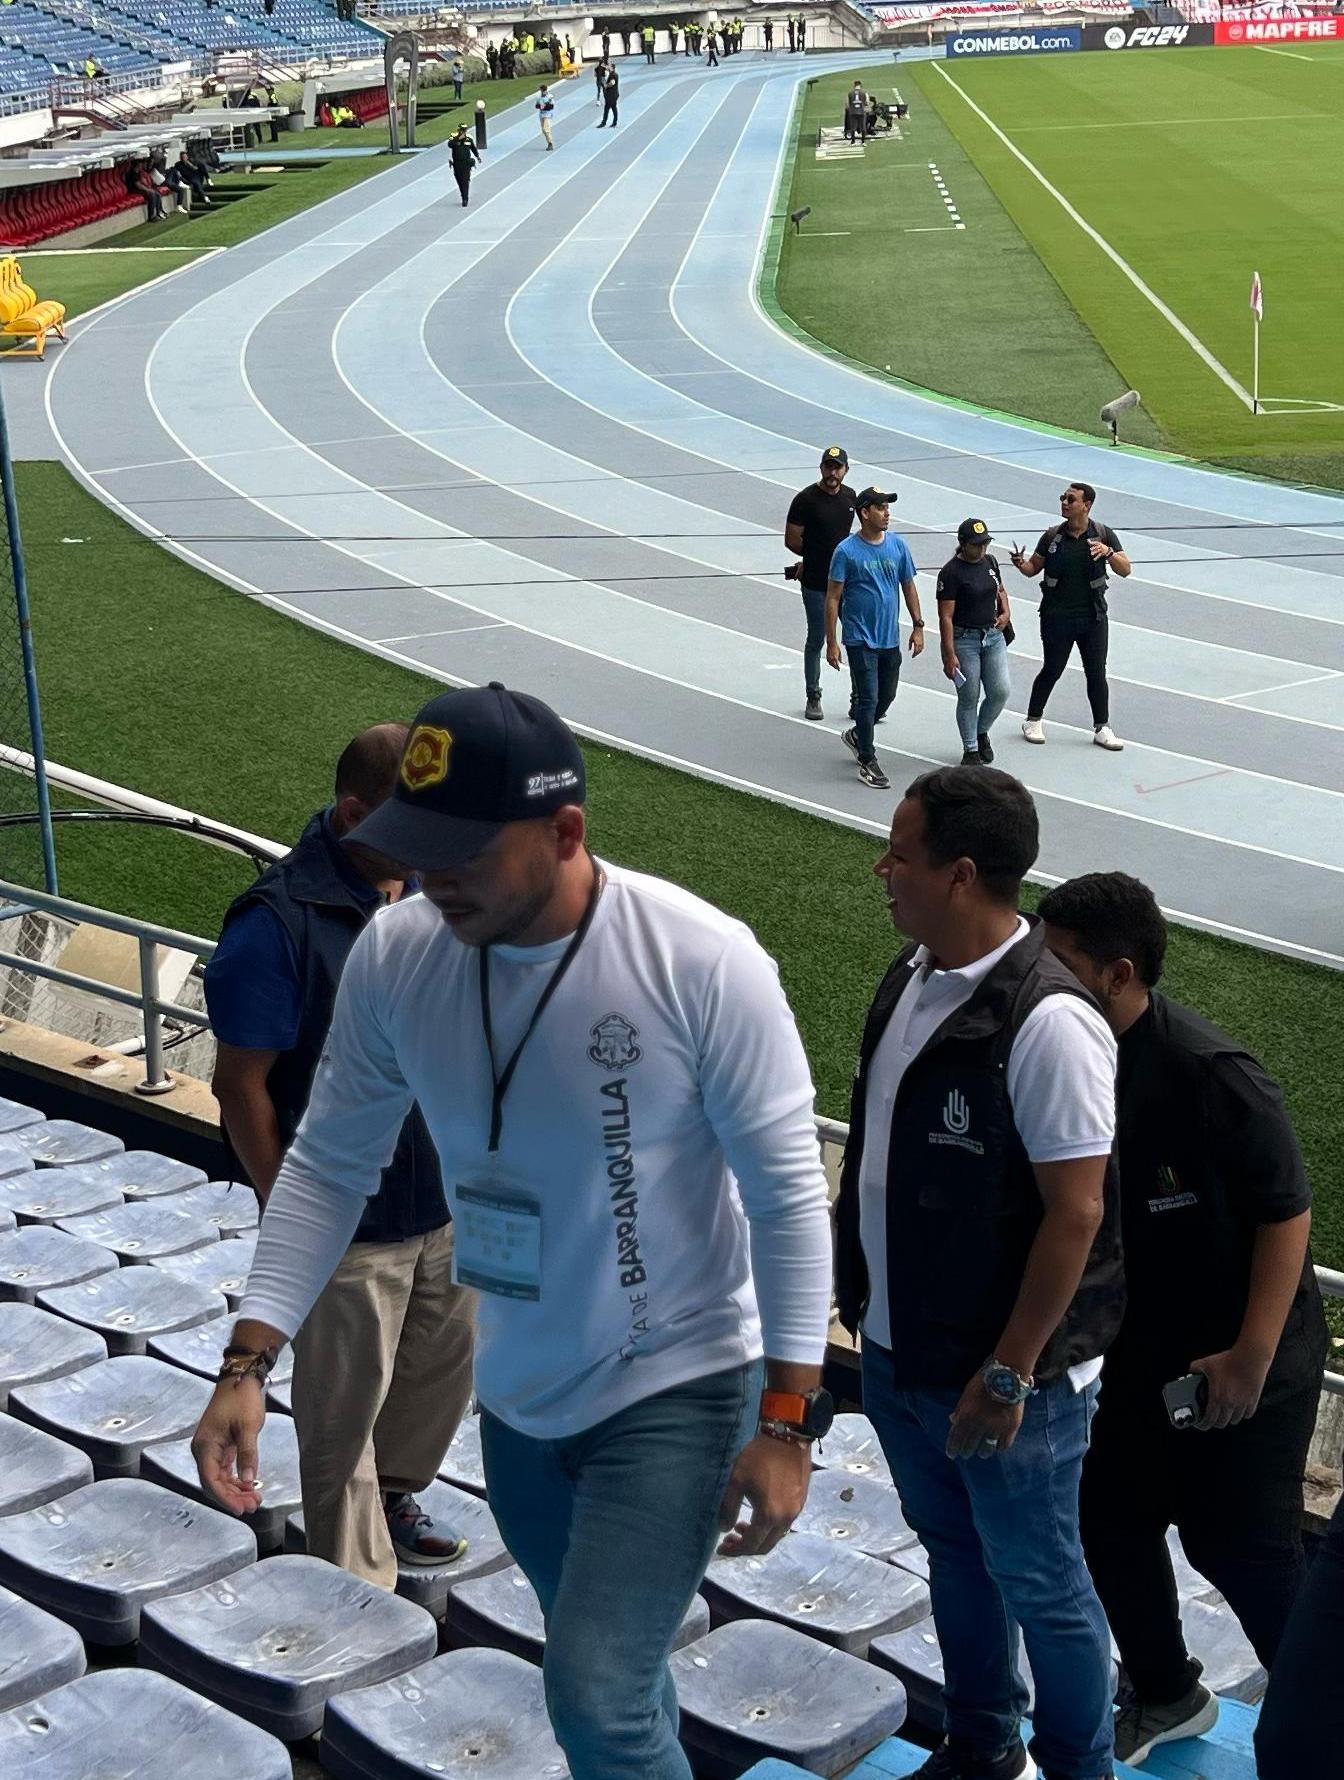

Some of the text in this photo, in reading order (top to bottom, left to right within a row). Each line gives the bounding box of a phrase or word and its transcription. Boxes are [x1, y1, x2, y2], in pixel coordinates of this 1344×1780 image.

[1245, 20, 1337, 39] MAPFRE
[599, 1077, 647, 1289] BARRANQUILLA
[629, 1291, 648, 1315] DE
